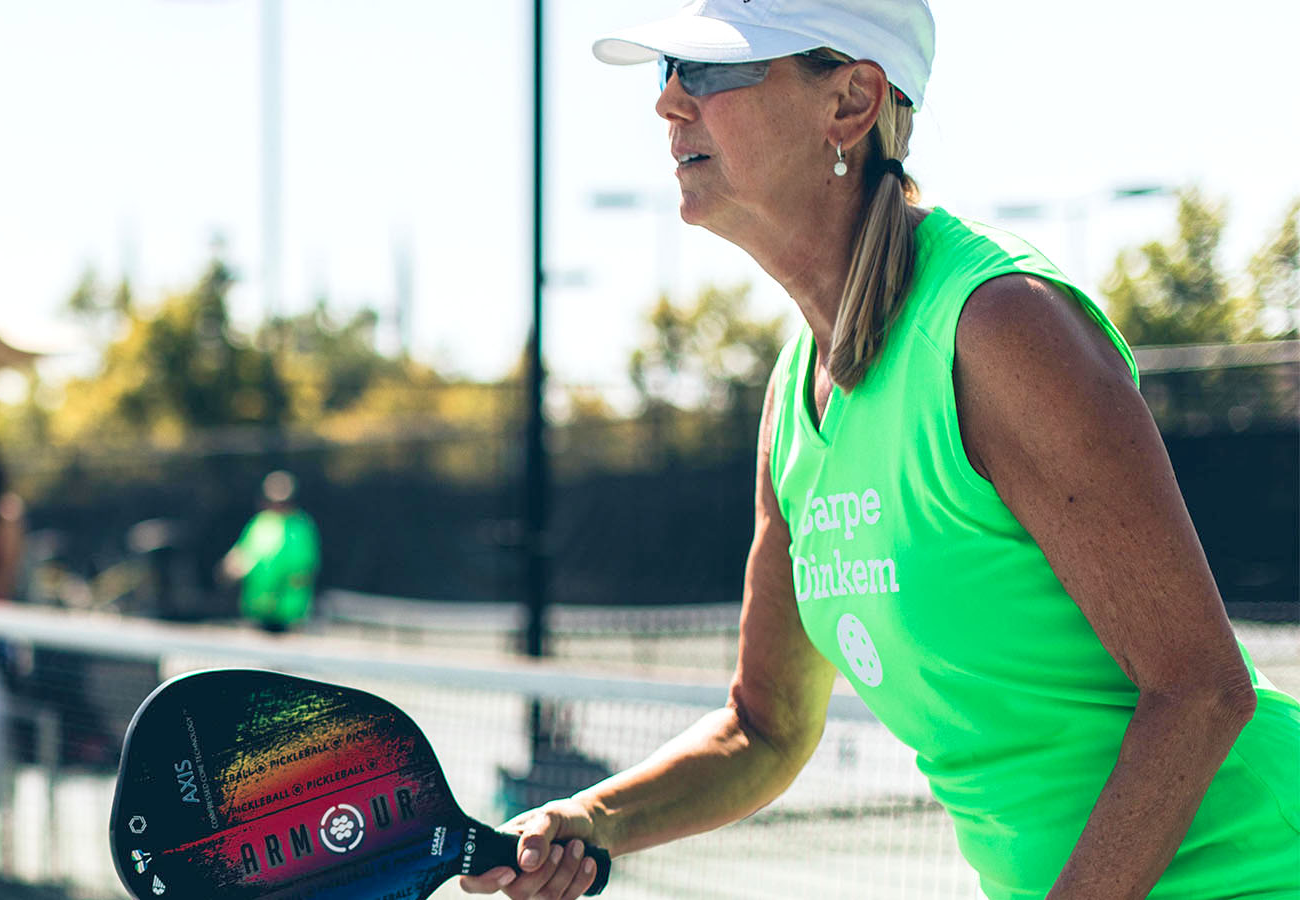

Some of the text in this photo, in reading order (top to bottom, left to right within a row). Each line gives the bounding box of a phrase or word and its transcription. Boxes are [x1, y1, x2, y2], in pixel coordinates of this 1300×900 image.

[793, 549, 900, 602] Dinkem
[269, 742, 329, 770] PICKLEBALL
[174, 759, 200, 803] AXIS
[231, 764, 365, 816] PICKLEBALL PICKLEBALL
